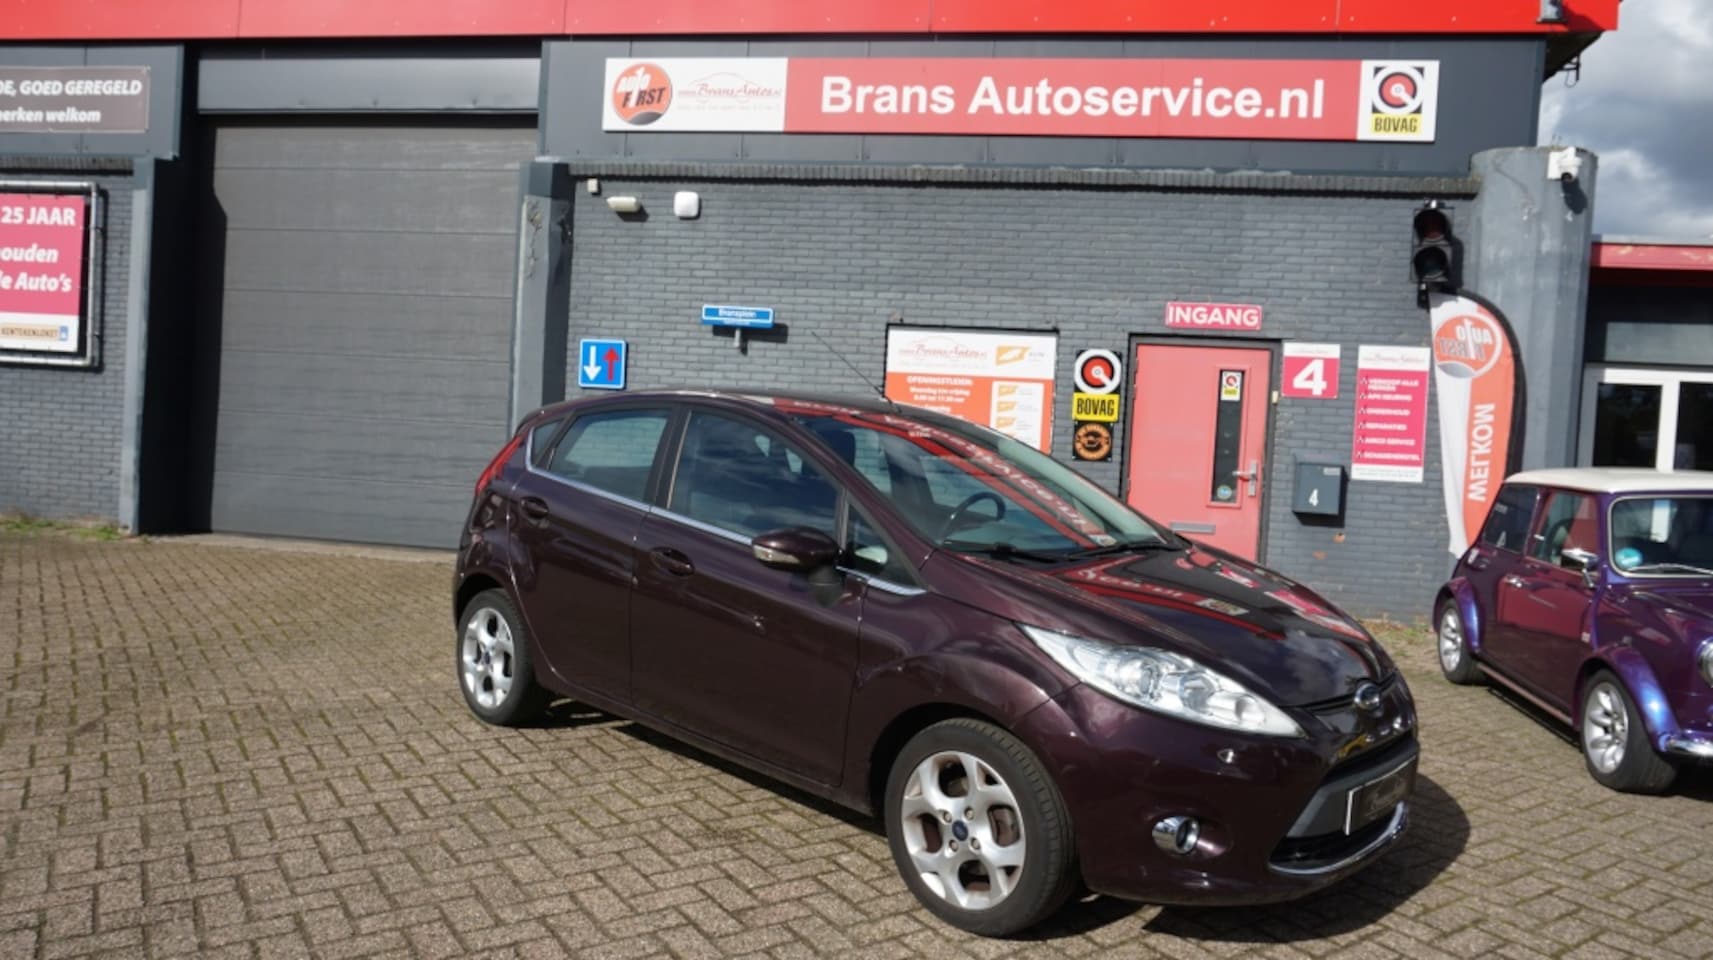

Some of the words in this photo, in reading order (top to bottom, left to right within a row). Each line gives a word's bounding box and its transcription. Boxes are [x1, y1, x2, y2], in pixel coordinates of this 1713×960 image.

[20, 79, 63, 96] GOED
[65, 80, 142, 96] GEREGELD
[820, 75, 955, 116] Brans
[967, 76, 1324, 119] Autoservice.nl
[0, 106, 43, 122] erken
[46, 106, 101, 123] welkom
[1374, 117, 1418, 133] BOVAG
[1, 207, 24, 224] 25
[26, 206, 76, 227] JAAR
[0, 243, 59, 263] ouden
[14, 271, 72, 292] Auto's
[1168, 305, 1259, 327] INGANG
[1292, 359, 1327, 396] 4
[1076, 401, 1115, 416] BOVAG
[1308, 488, 1319, 507] 4
